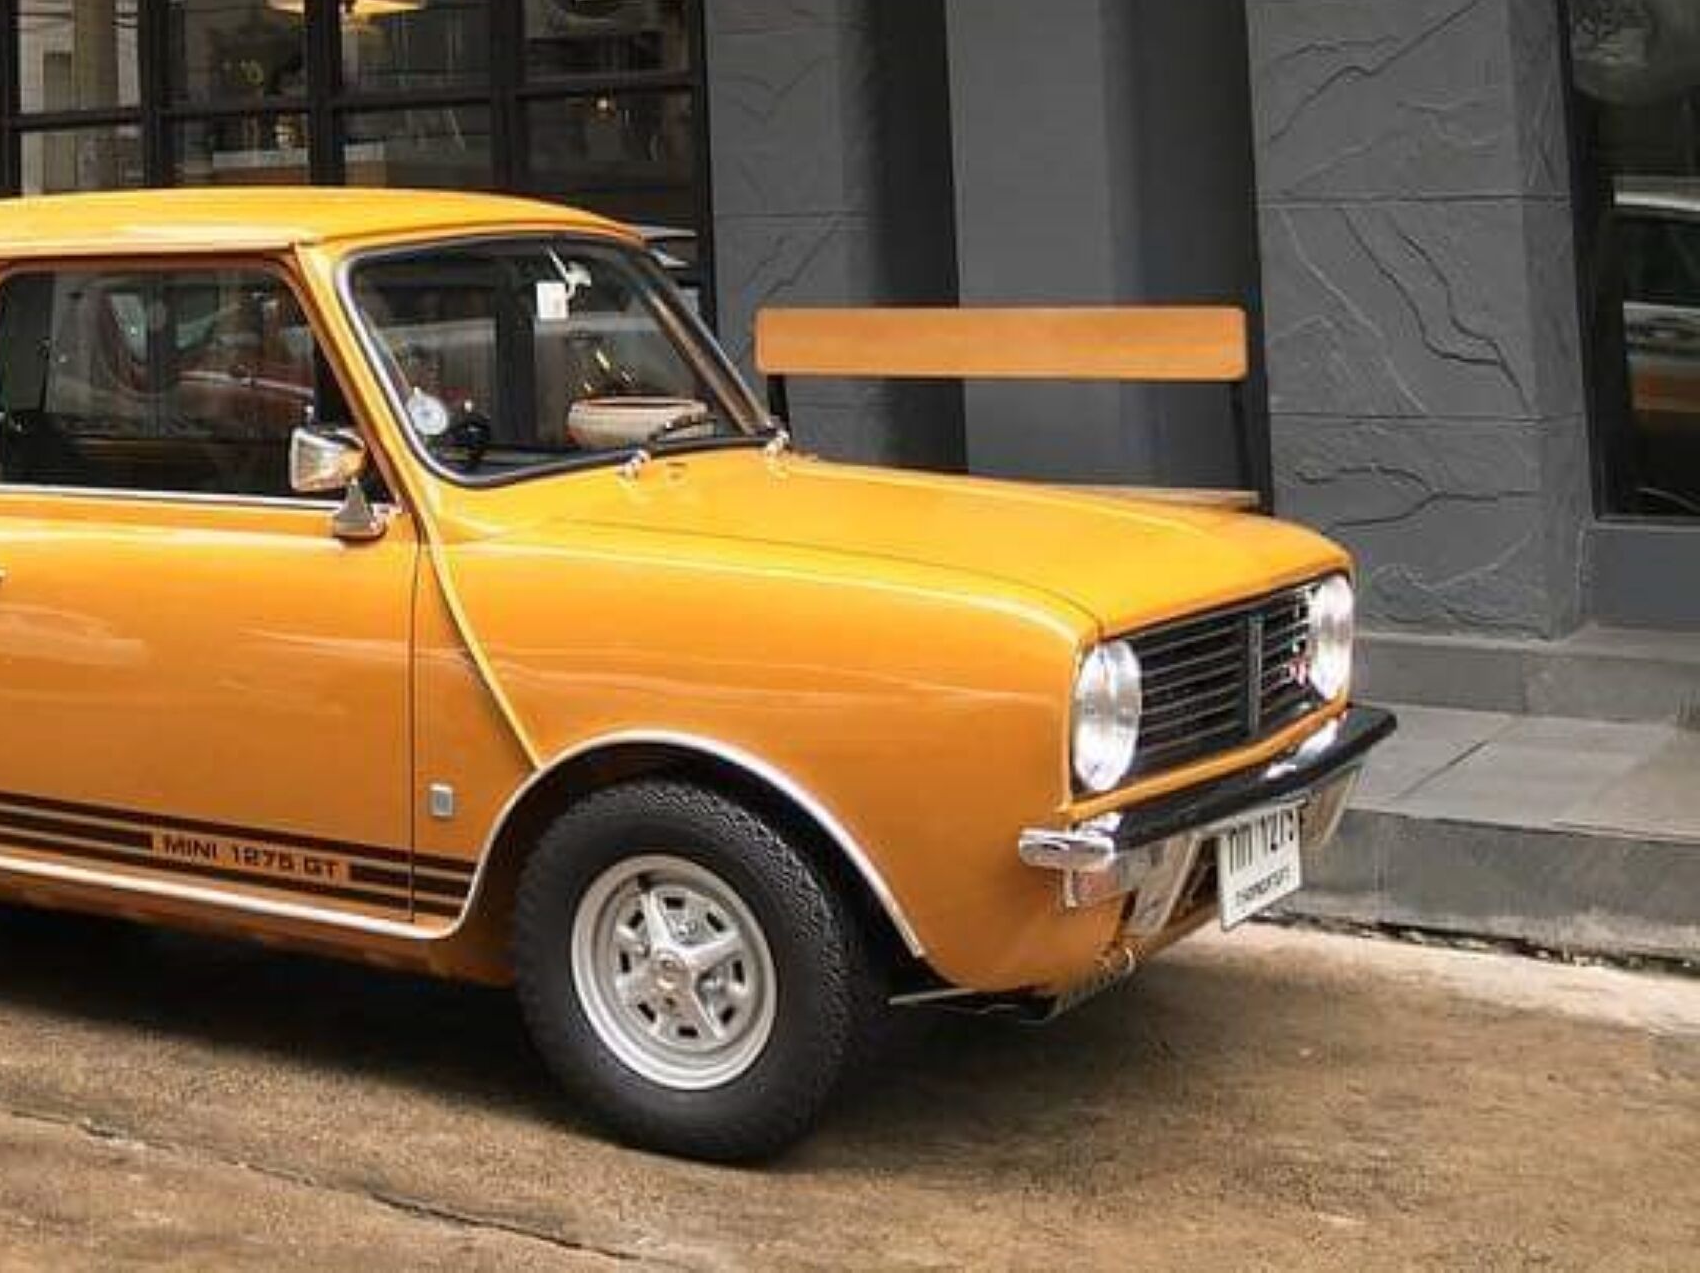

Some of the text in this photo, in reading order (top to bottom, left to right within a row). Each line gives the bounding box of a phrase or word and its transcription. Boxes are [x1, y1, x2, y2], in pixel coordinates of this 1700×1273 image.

[162, 833, 340, 879] MINI 1275 GT
